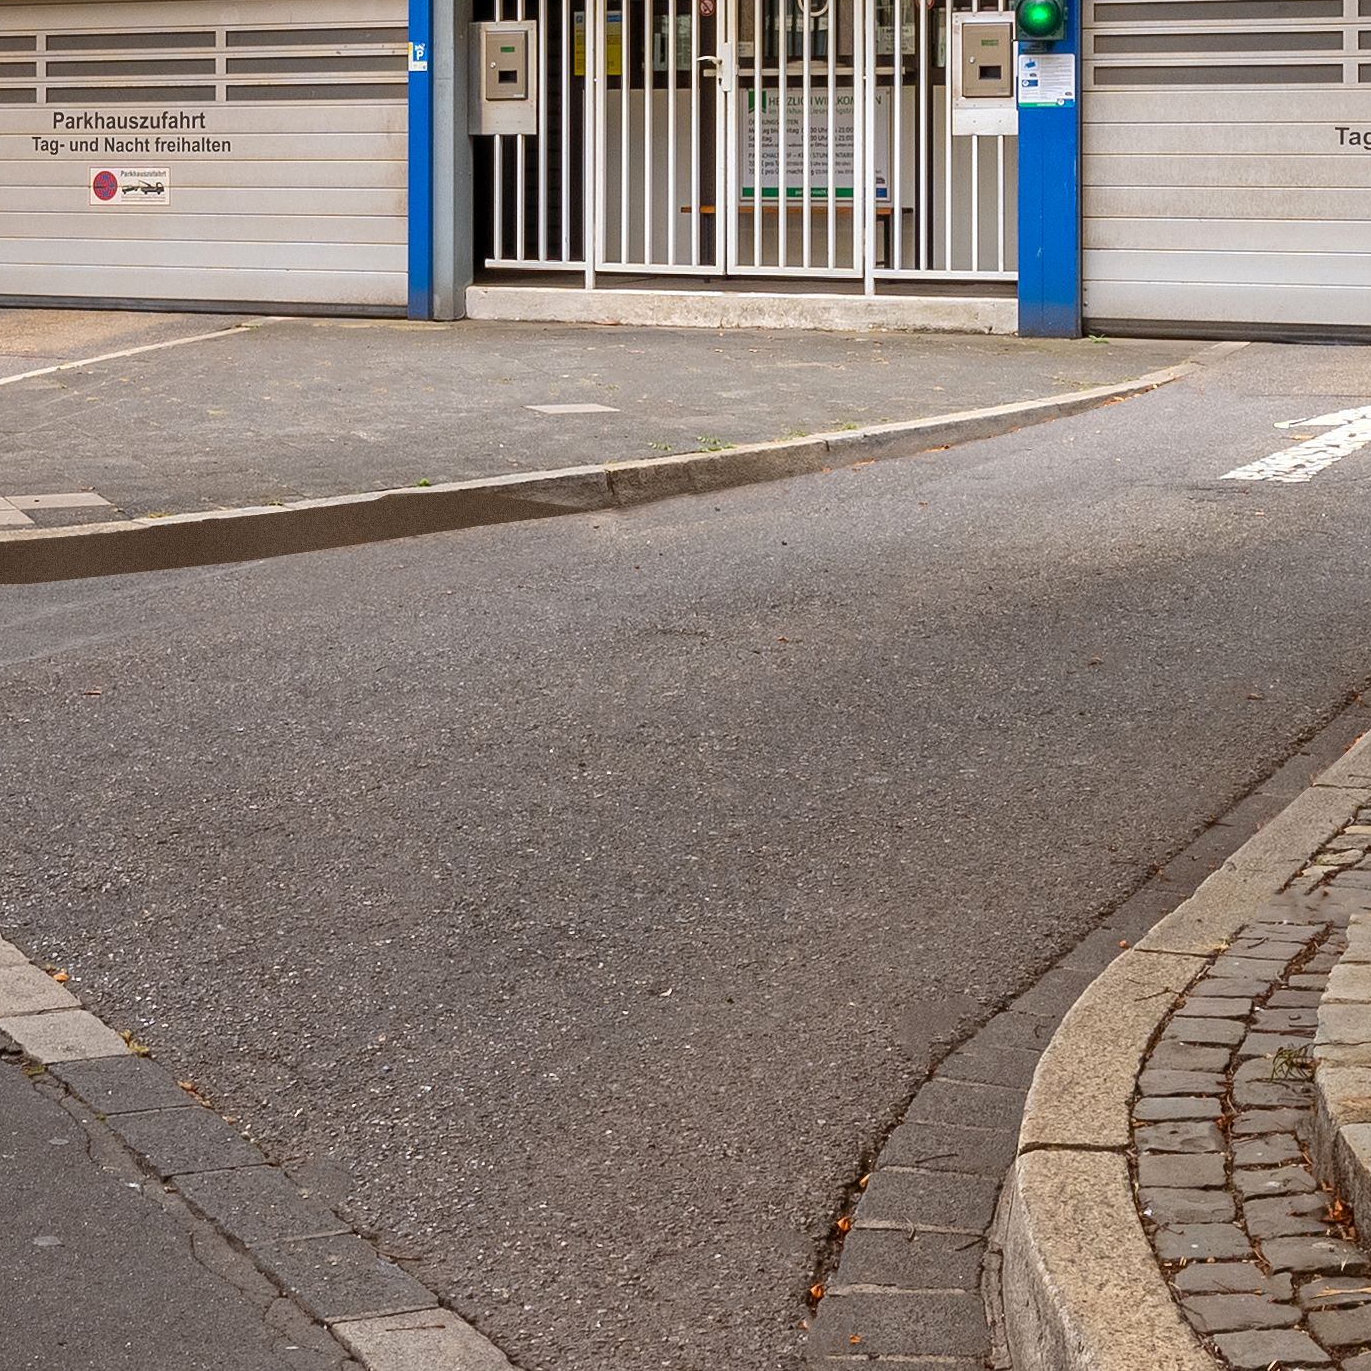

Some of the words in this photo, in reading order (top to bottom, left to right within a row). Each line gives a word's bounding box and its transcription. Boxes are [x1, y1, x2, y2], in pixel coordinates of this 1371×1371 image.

[53, 111, 205, 129] Parkhauszufahrt
[32, 136, 65, 155] Tag-
[69, 137, 99, 152] und
[104, 137, 150, 152] Nacht
[155, 136, 231, 152] freihalten
